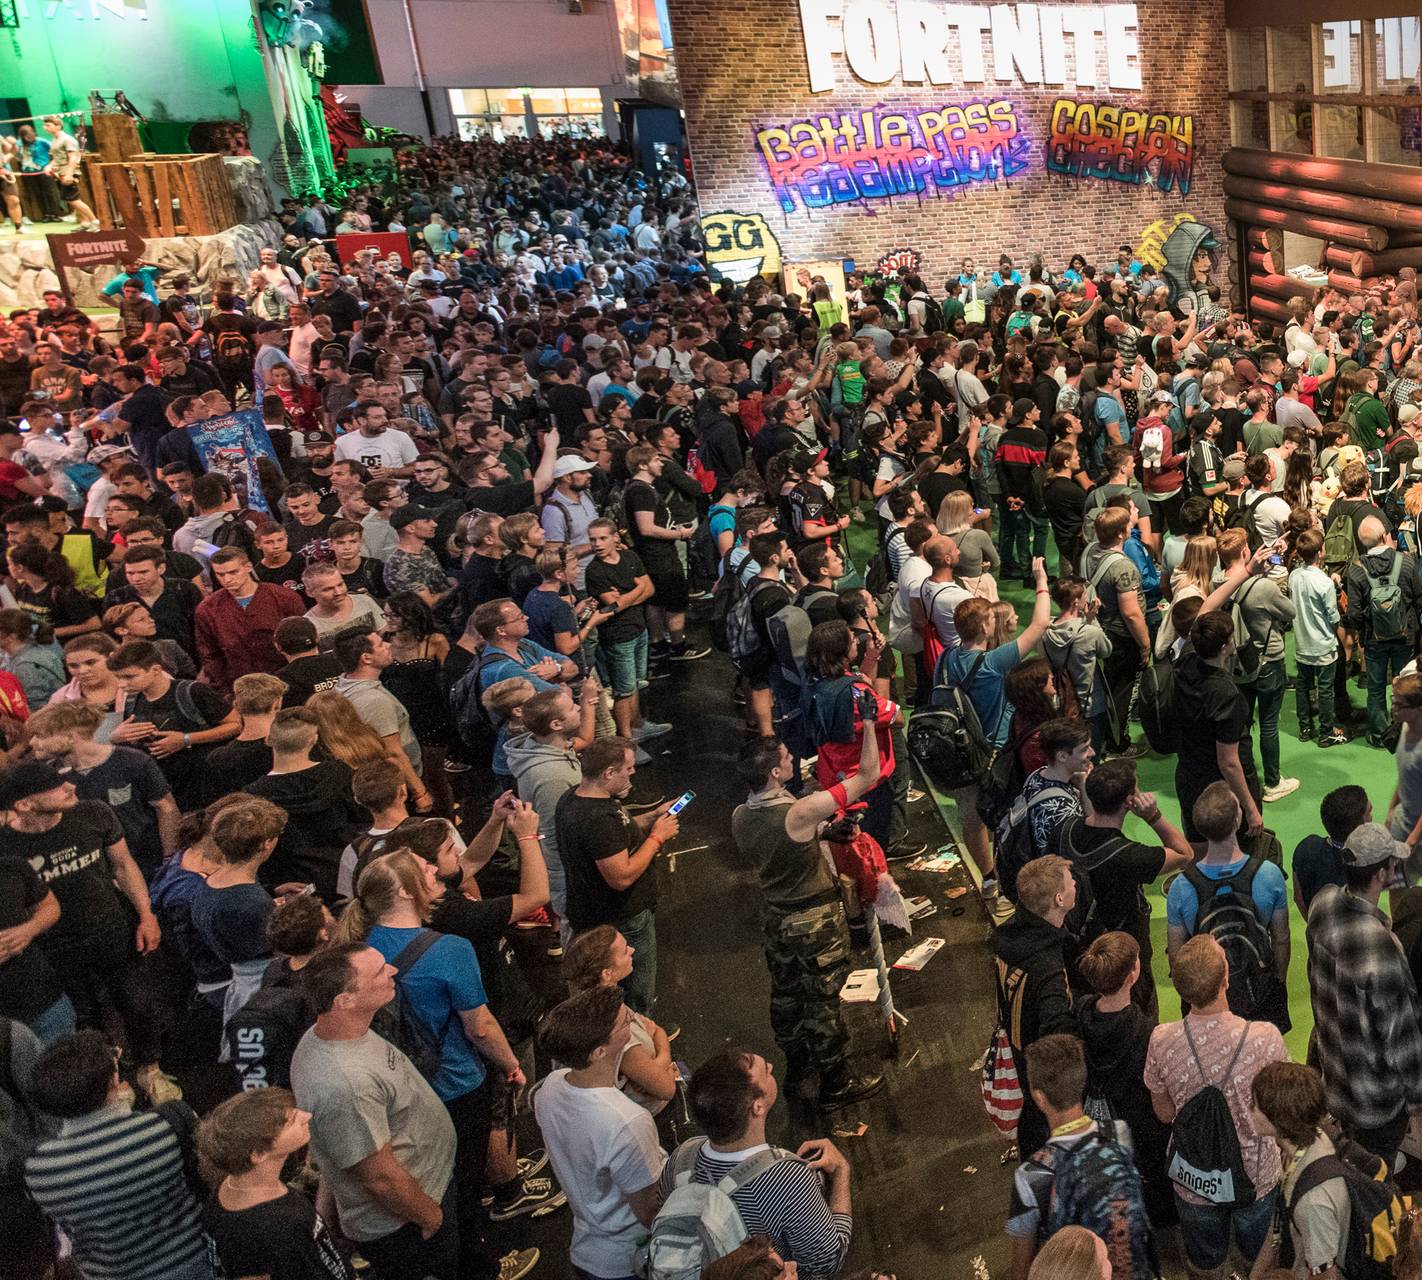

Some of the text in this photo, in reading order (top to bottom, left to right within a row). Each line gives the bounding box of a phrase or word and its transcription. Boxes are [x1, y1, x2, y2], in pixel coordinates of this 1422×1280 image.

[799, 0, 1141, 93] FORTNITE
[65, 240, 129, 257] FORTNITE
[703, 219, 764, 252] GG
[38, 848, 101, 883] MMER
